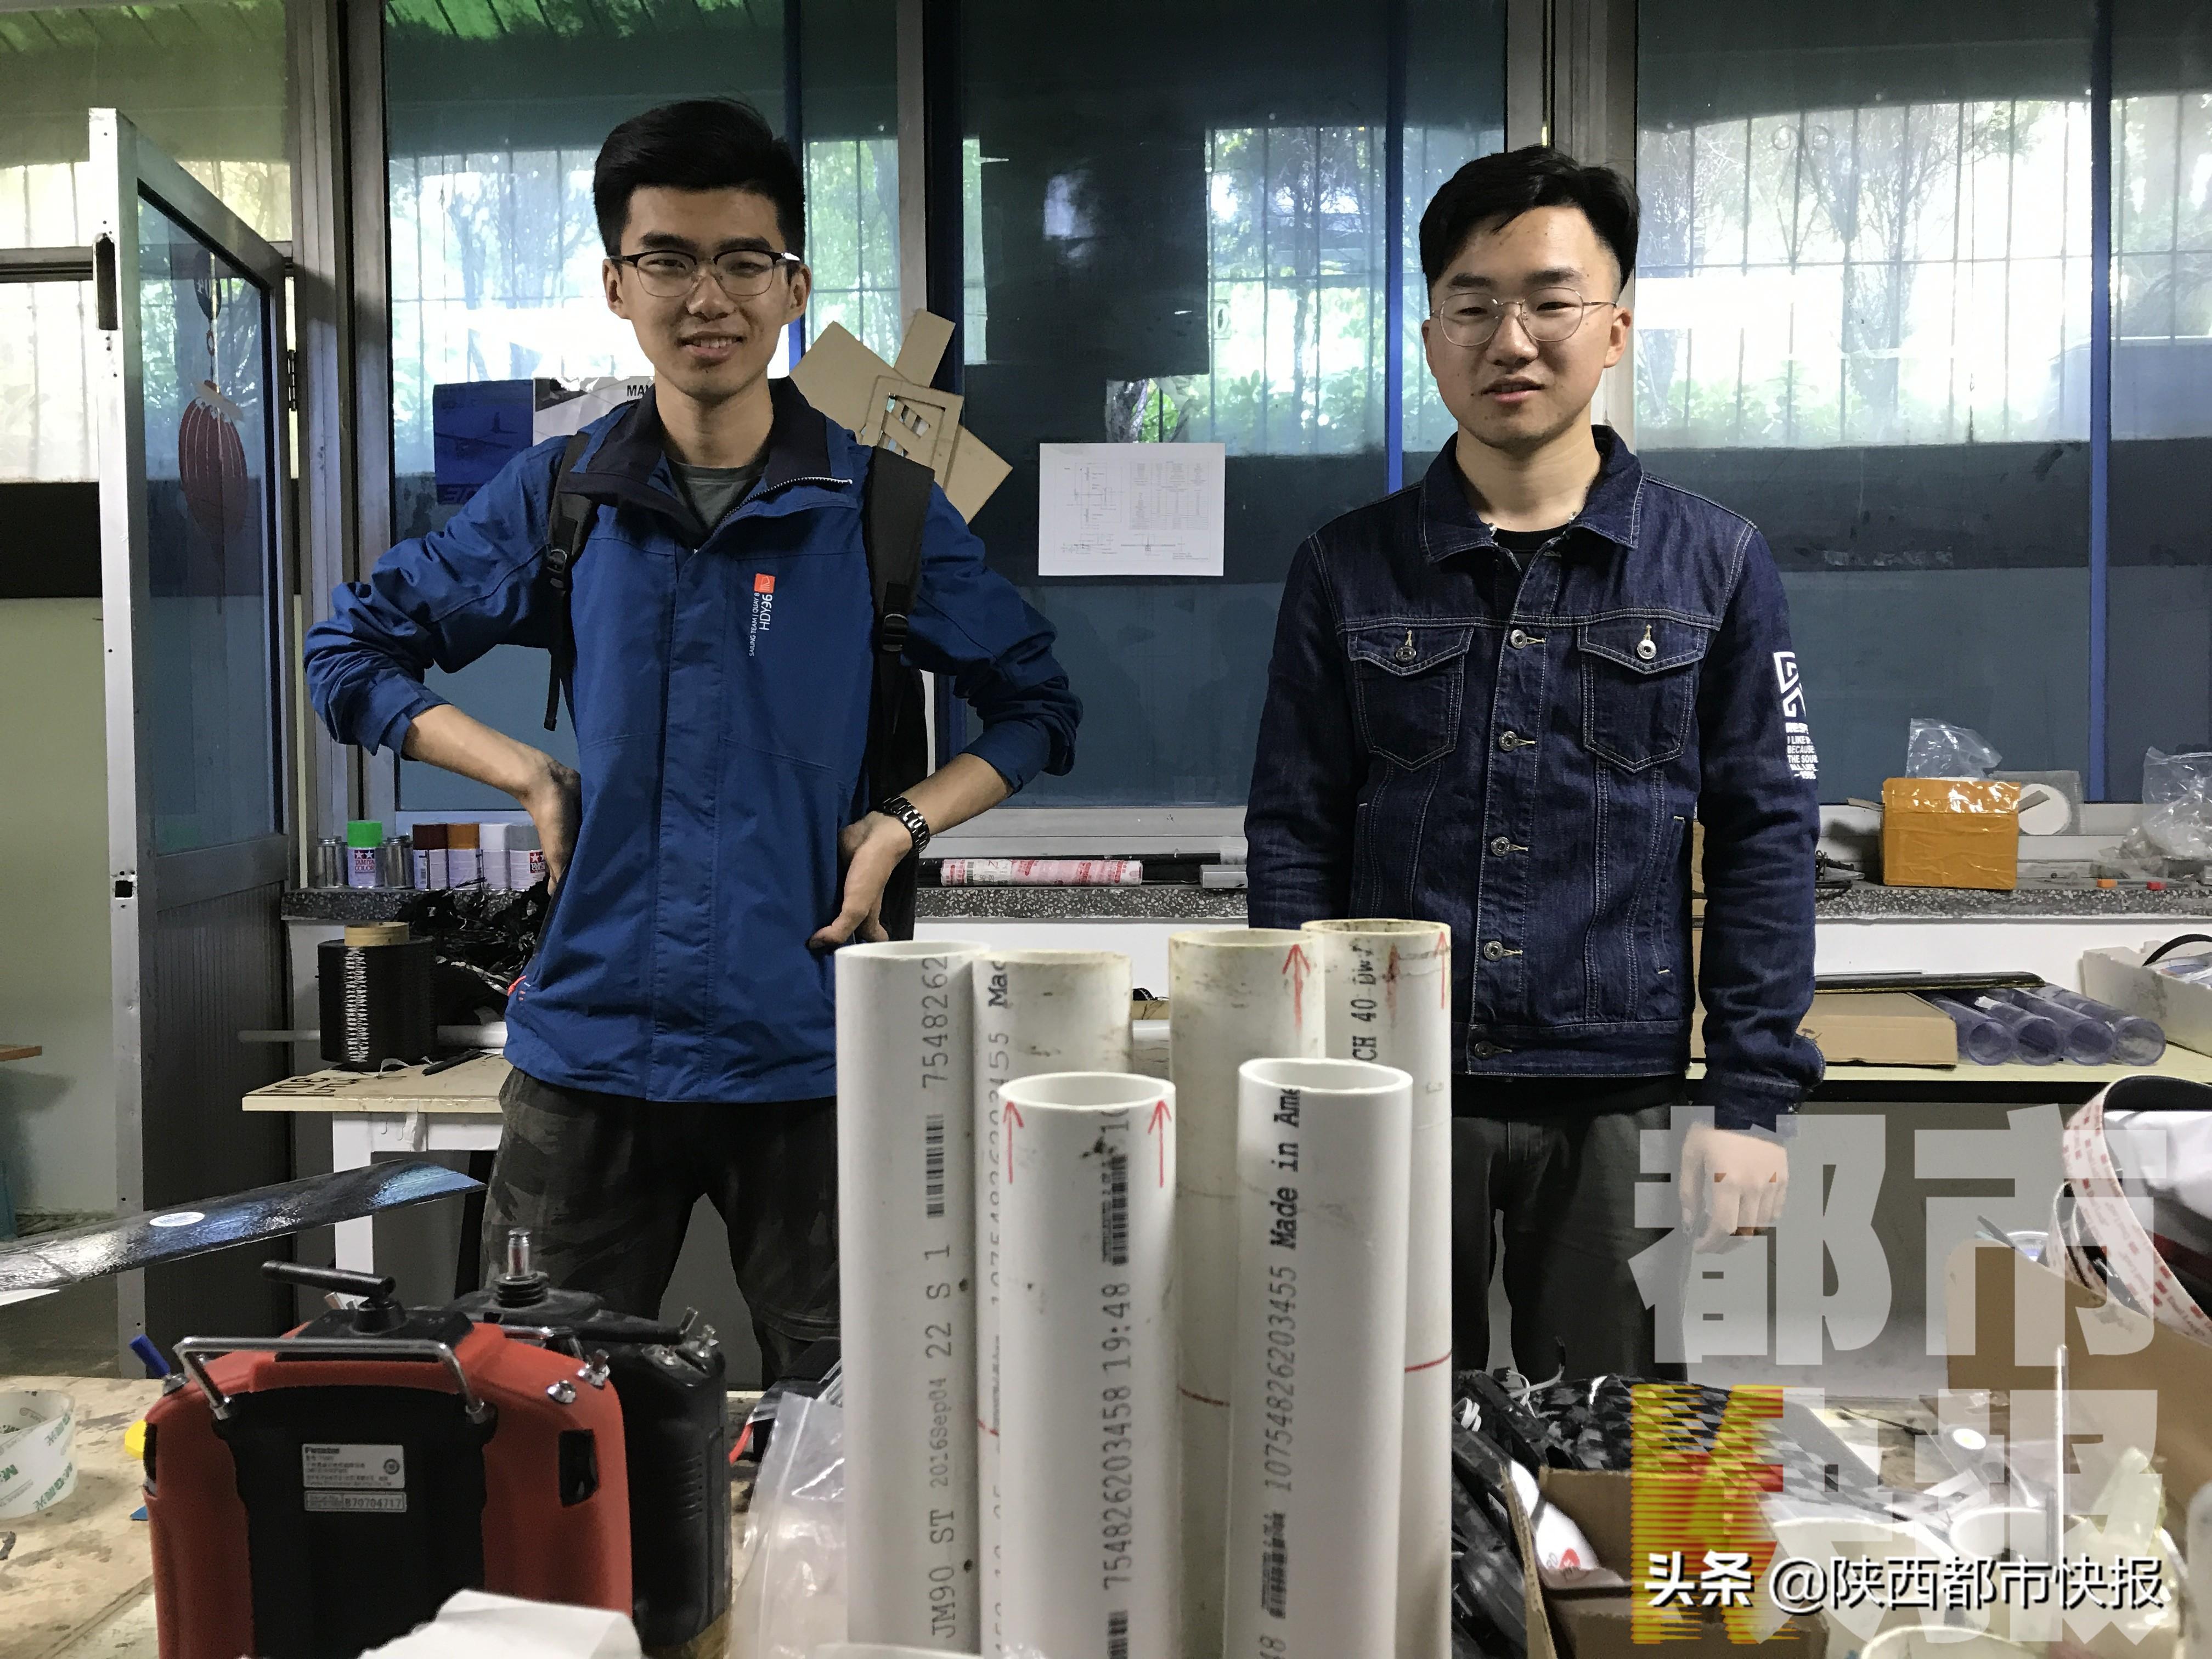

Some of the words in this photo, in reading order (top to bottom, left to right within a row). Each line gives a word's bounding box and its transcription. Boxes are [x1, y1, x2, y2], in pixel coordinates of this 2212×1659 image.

[1787, 745, 1816, 754] BECAUSE
[1791, 736, 1805, 744] LIKE
[1787, 754, 1801, 763] THE
[921, 956, 949, 1088] 7548262
[1350, 999, 1378, 1022] 40
[1271, 1142, 1299, 1172] in
[1269, 1187, 1299, 1250] Made
[924, 1244, 951, 1260] 1
[926, 1283, 951, 1300] S
[925, 1322, 951, 1358] 22
[1102, 1282, 1132, 1372] 19:48
[1264, 1265, 1297, 1492] 10754826203455
[929, 1378, 951, 1488] 2016Sep04
[1103, 1385, 1133, 1590] 754826203458
[929, 1509, 955, 1544] ST
[928, 1566, 956, 1638] JM90
